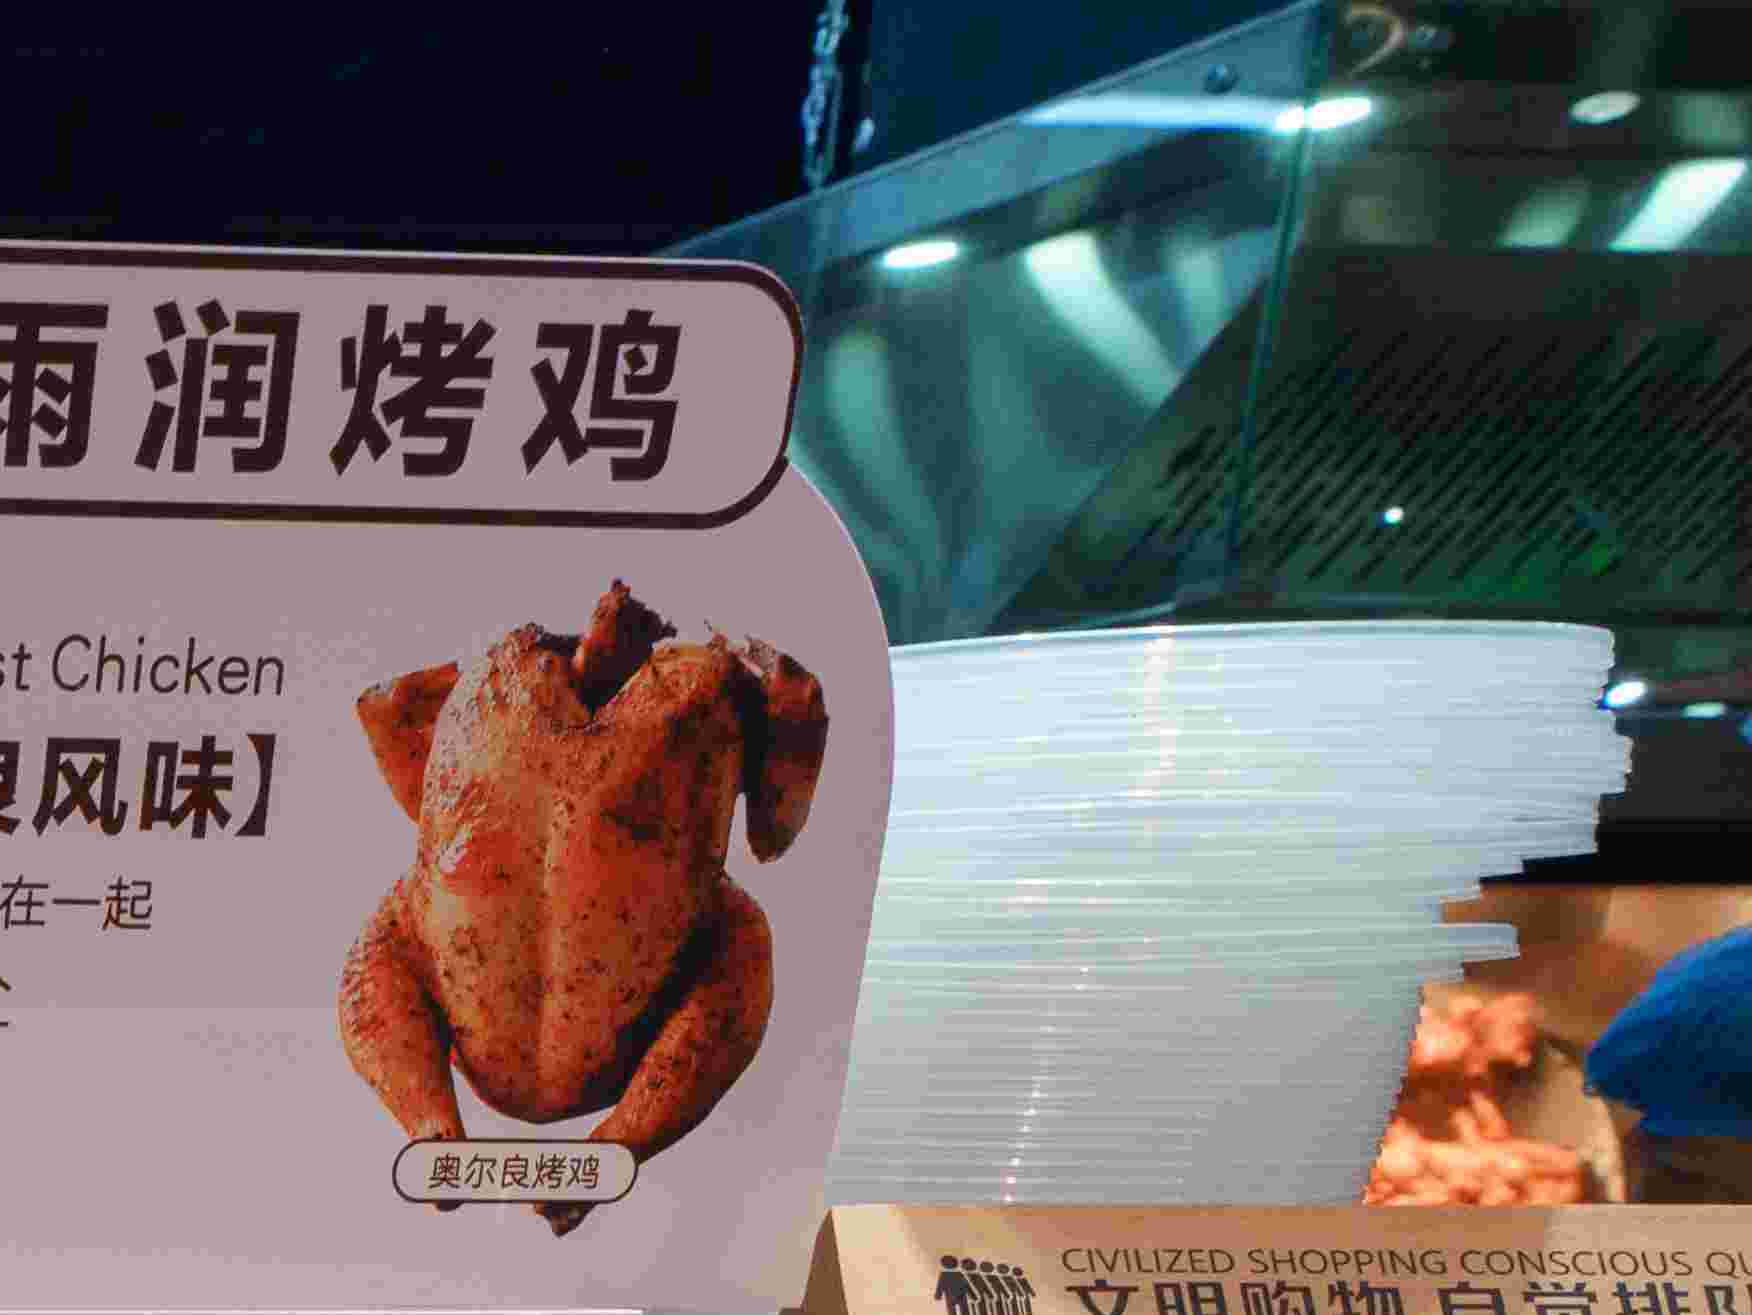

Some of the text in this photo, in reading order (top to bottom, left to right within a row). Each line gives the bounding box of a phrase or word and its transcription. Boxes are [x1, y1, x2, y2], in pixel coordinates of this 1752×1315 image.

[50, 634, 284, 698] Chicken
[426, 1150, 600, 1193] 奥尔良烤鸡
[1062, 1248, 1236, 1275] CIVILIZED
[1248, 1249, 1448, 1276] SHOPPING
[1460, 1250, 1693, 1276] CONSCIOUS
